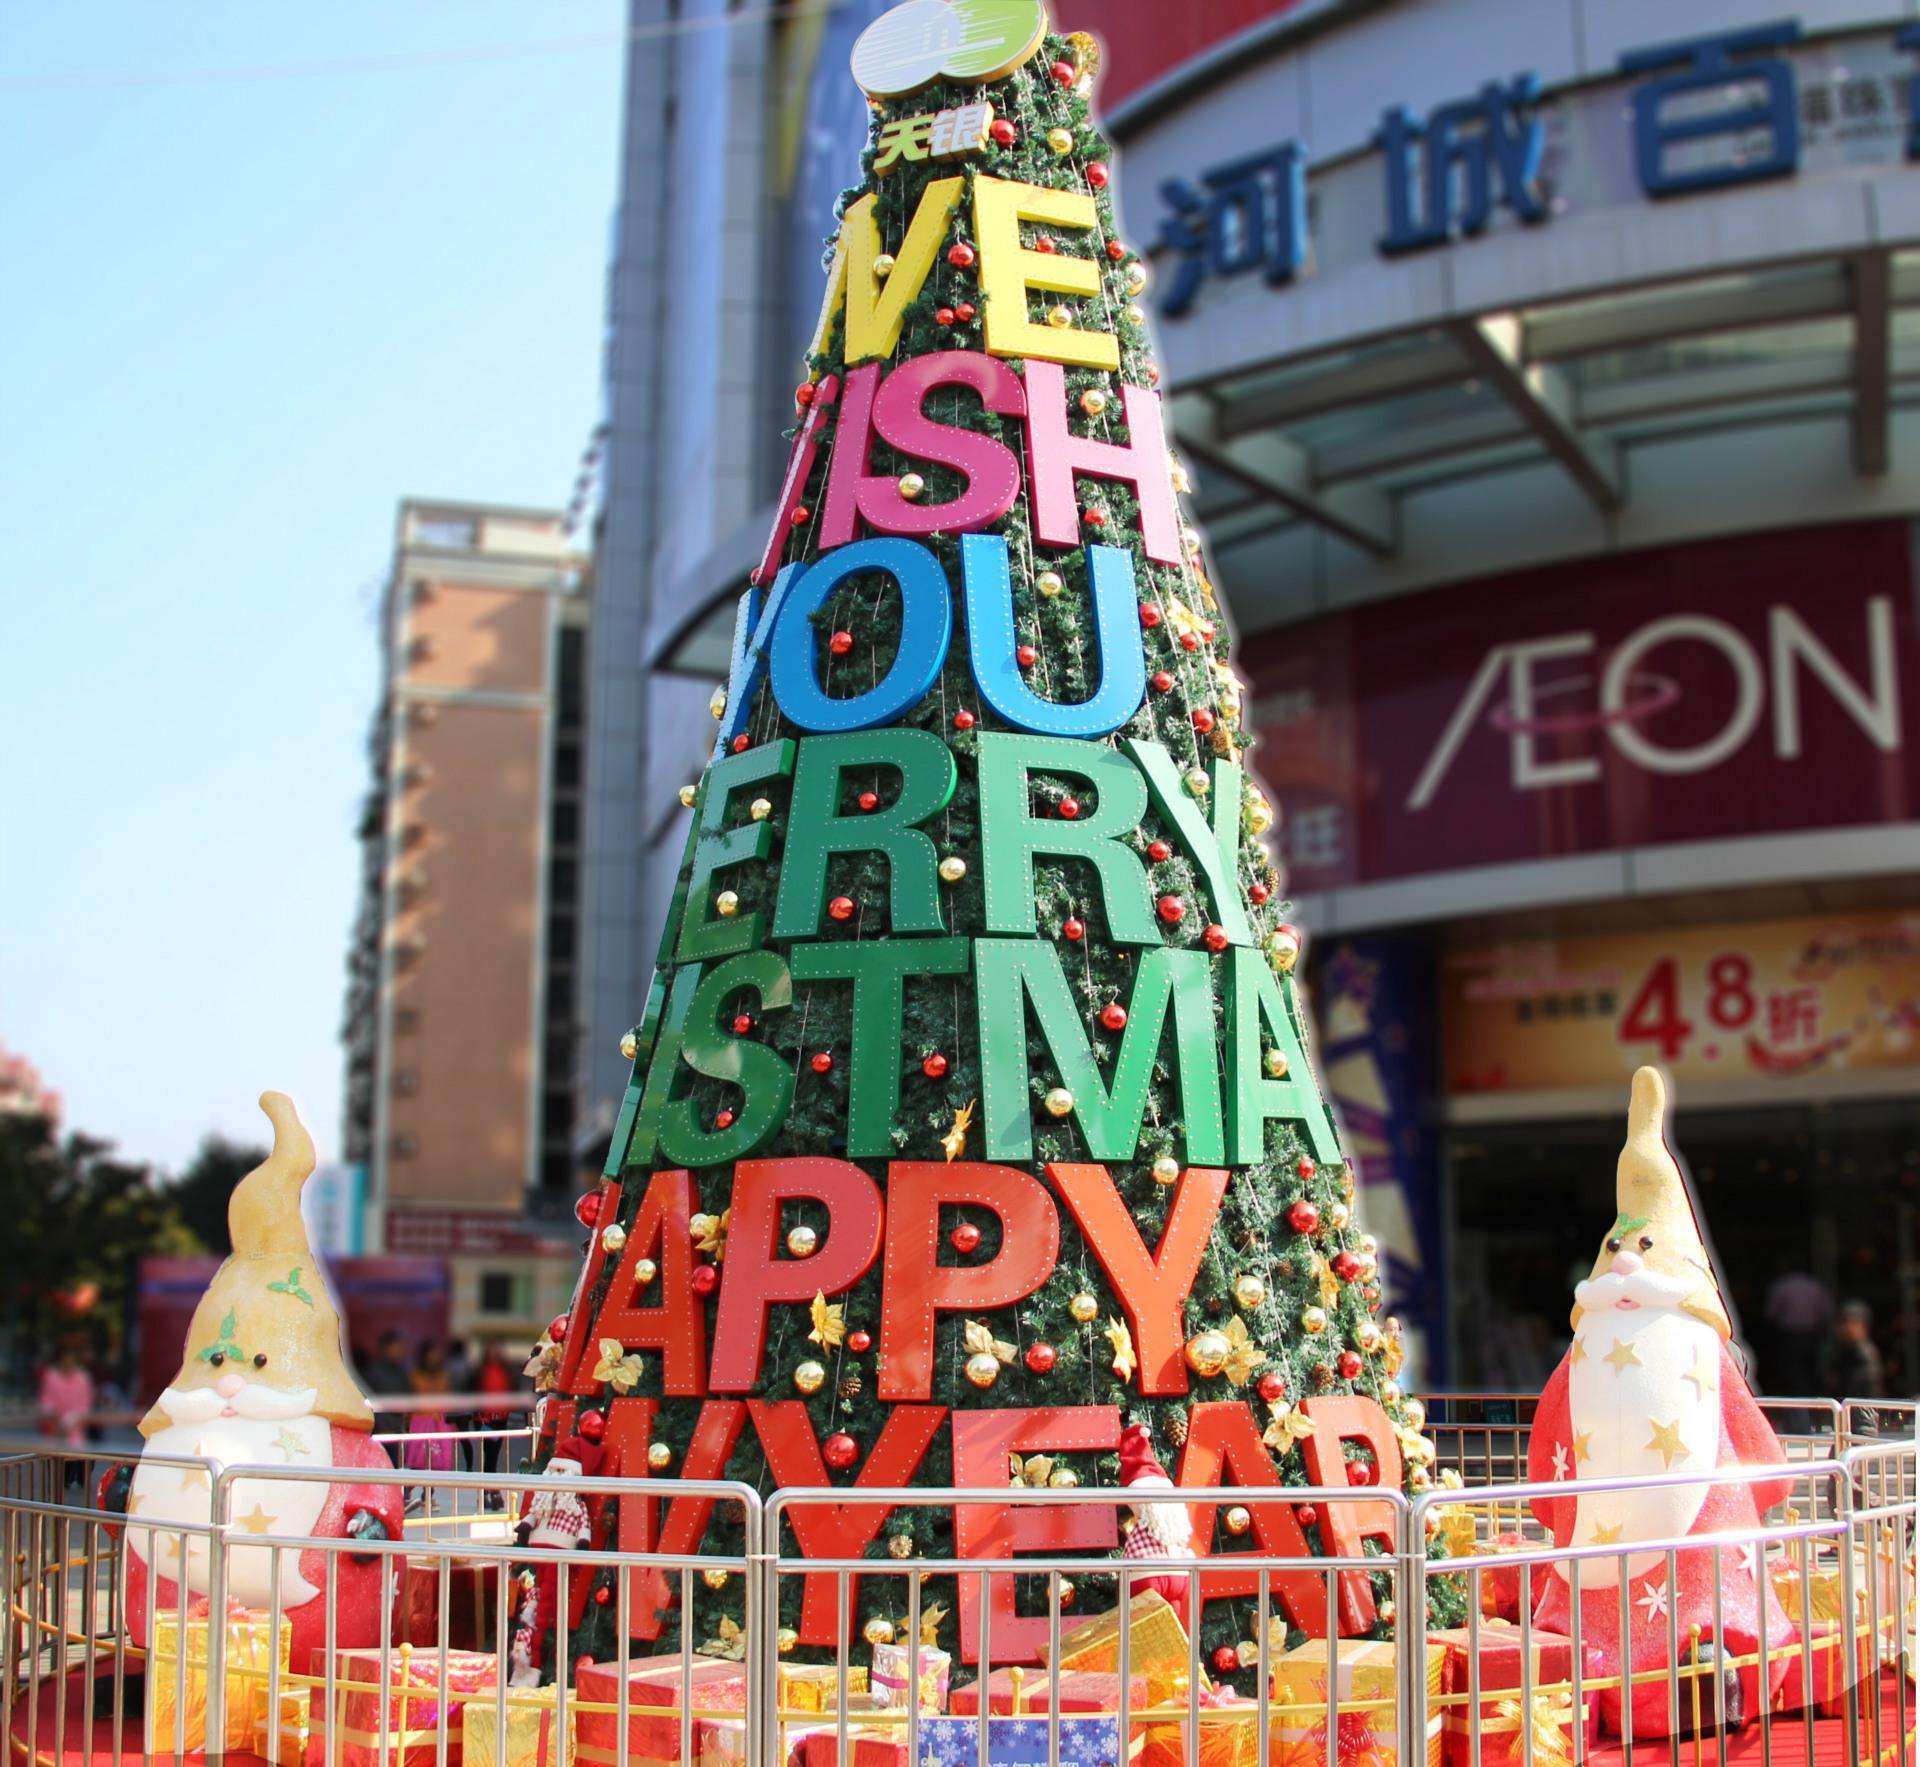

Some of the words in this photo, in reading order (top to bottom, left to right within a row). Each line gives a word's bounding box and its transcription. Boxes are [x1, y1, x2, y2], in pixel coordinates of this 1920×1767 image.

[1160, 18, 1920, 320] 河城百
[757, 350, 1182, 587] ISH
[713, 533, 1147, 762] YOU
[657, 727, 1252, 963] ERRY
[604, 936, 1345, 1178] ISTMA
[559, 1156, 1232, 1401] APPY
